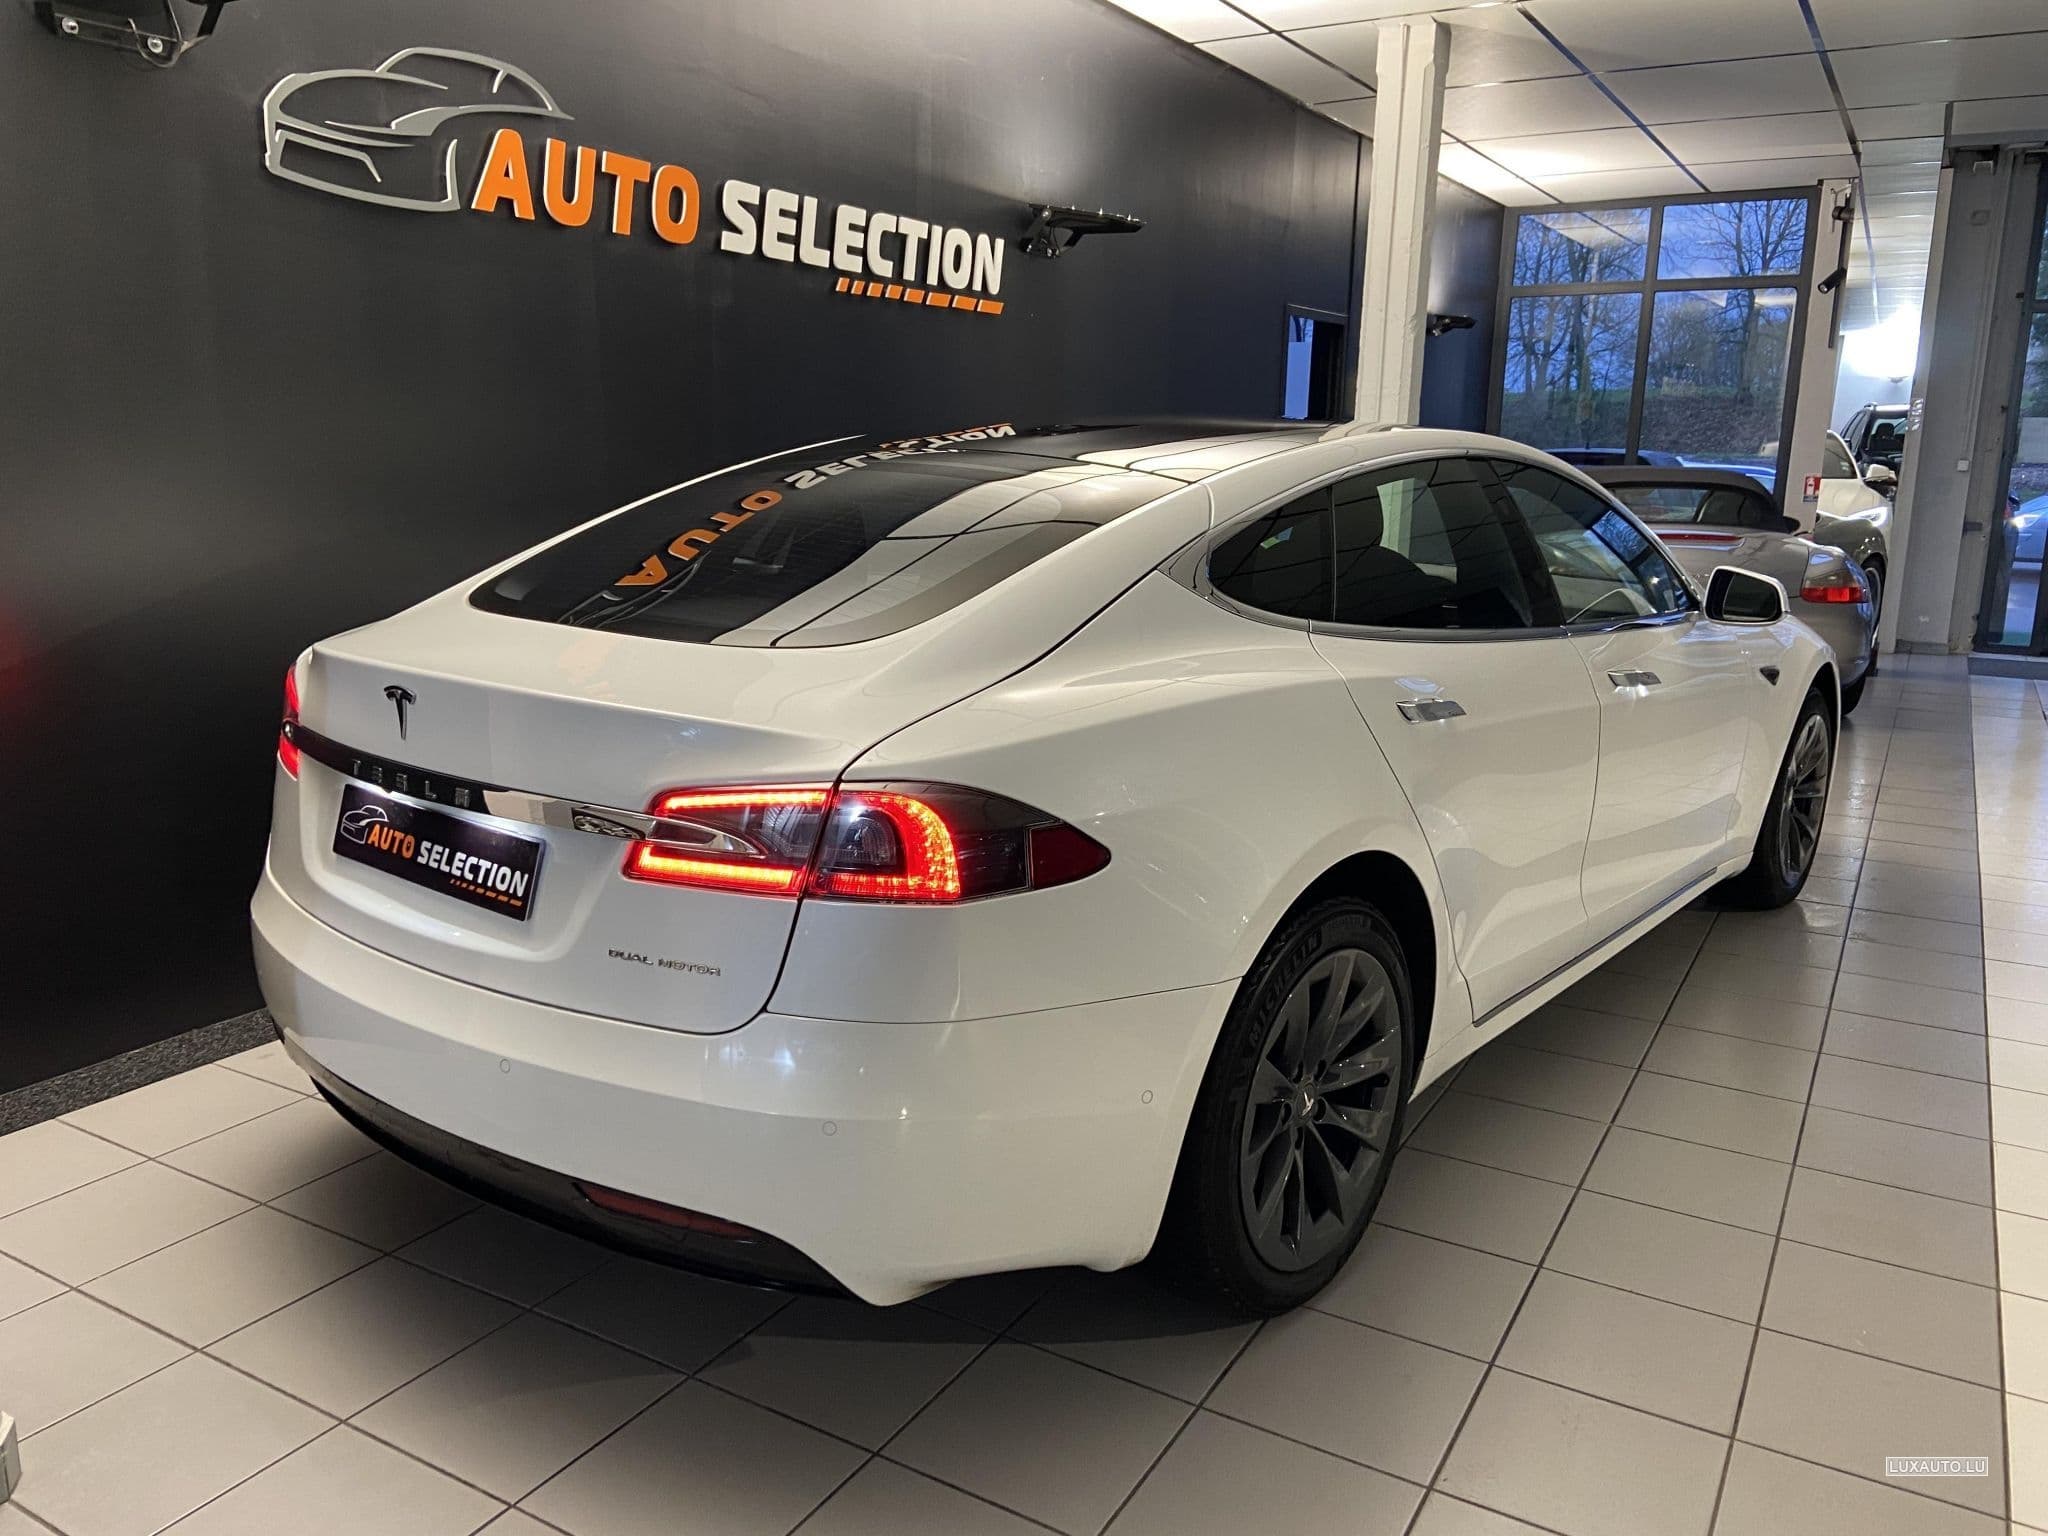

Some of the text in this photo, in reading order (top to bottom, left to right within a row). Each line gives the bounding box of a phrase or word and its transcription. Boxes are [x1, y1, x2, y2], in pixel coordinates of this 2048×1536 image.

[471, 128, 1005, 295] AUTO SELECTION
[367, 823, 529, 898] AUTO SELECTION
[608, 949, 721, 976] DUAL MOTOR
